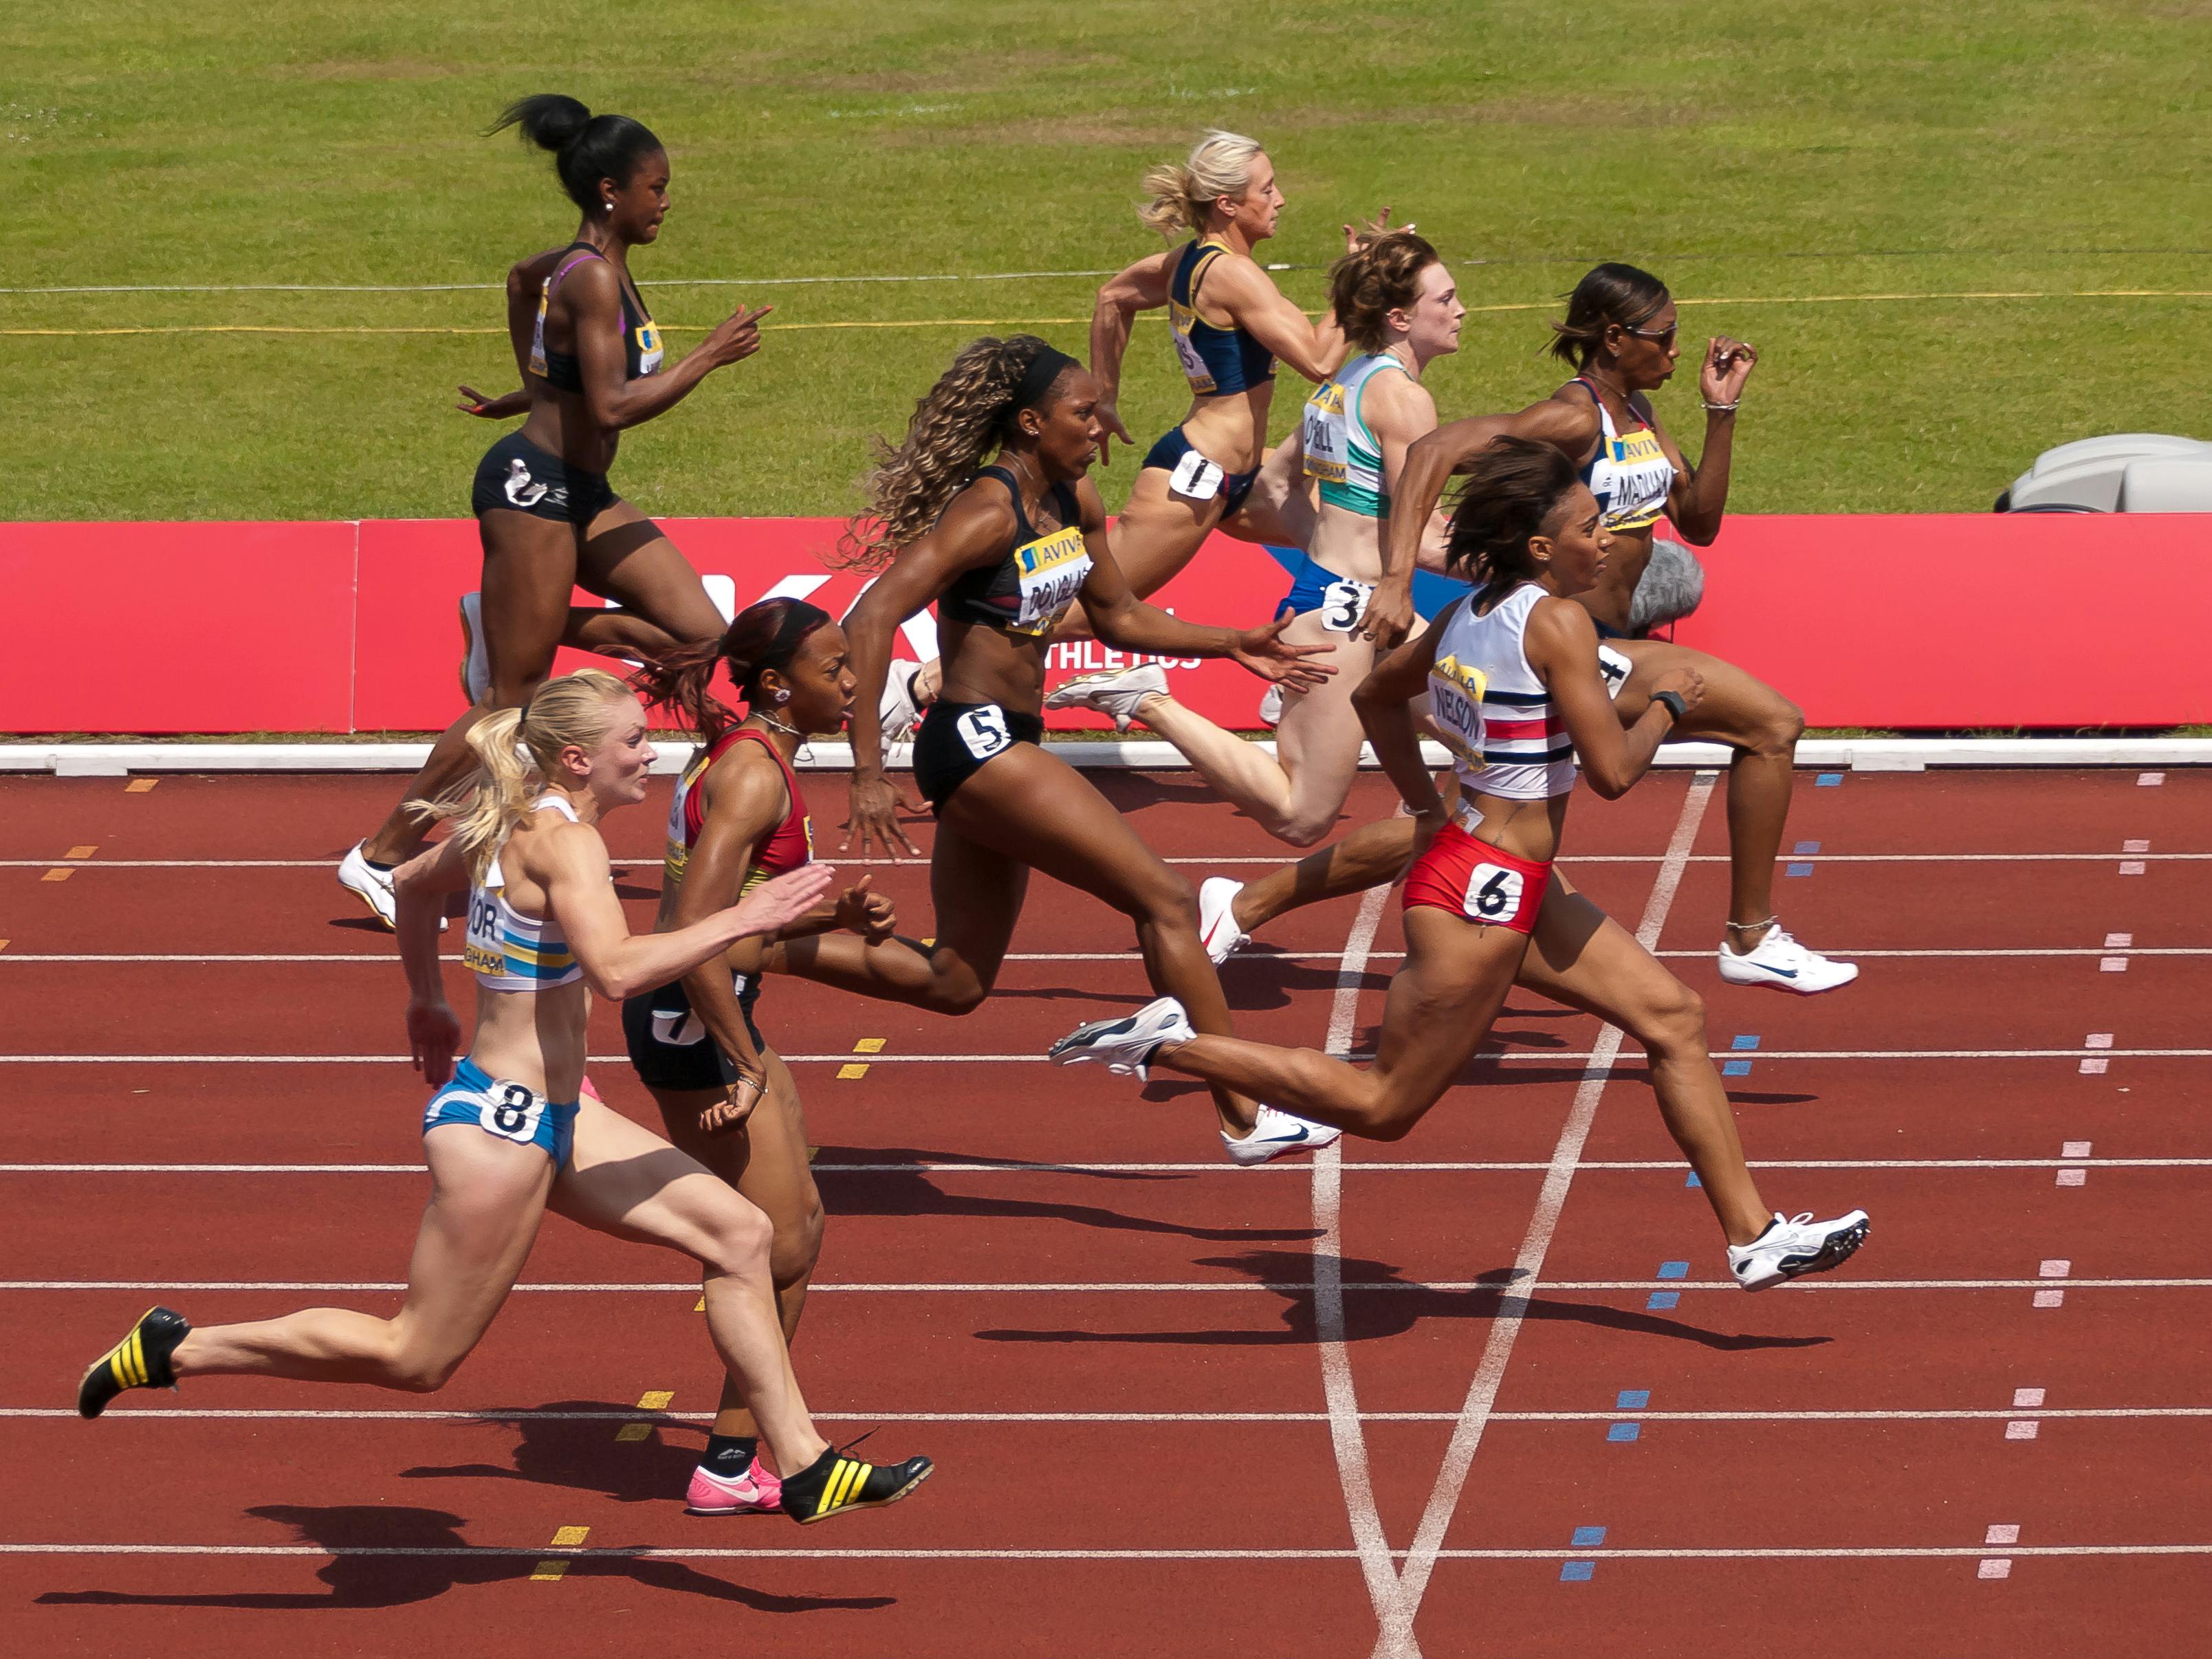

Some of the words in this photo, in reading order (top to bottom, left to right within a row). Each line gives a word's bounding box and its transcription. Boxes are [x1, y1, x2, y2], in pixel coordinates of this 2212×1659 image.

[1332, 586, 1359, 628] 3
[968, 710, 1002, 752] 5
[1434, 685, 1480, 740] NELSON
[1477, 870, 1510, 916] 6
[469, 896, 496, 941] OR
[494, 1084, 533, 1133] 8
